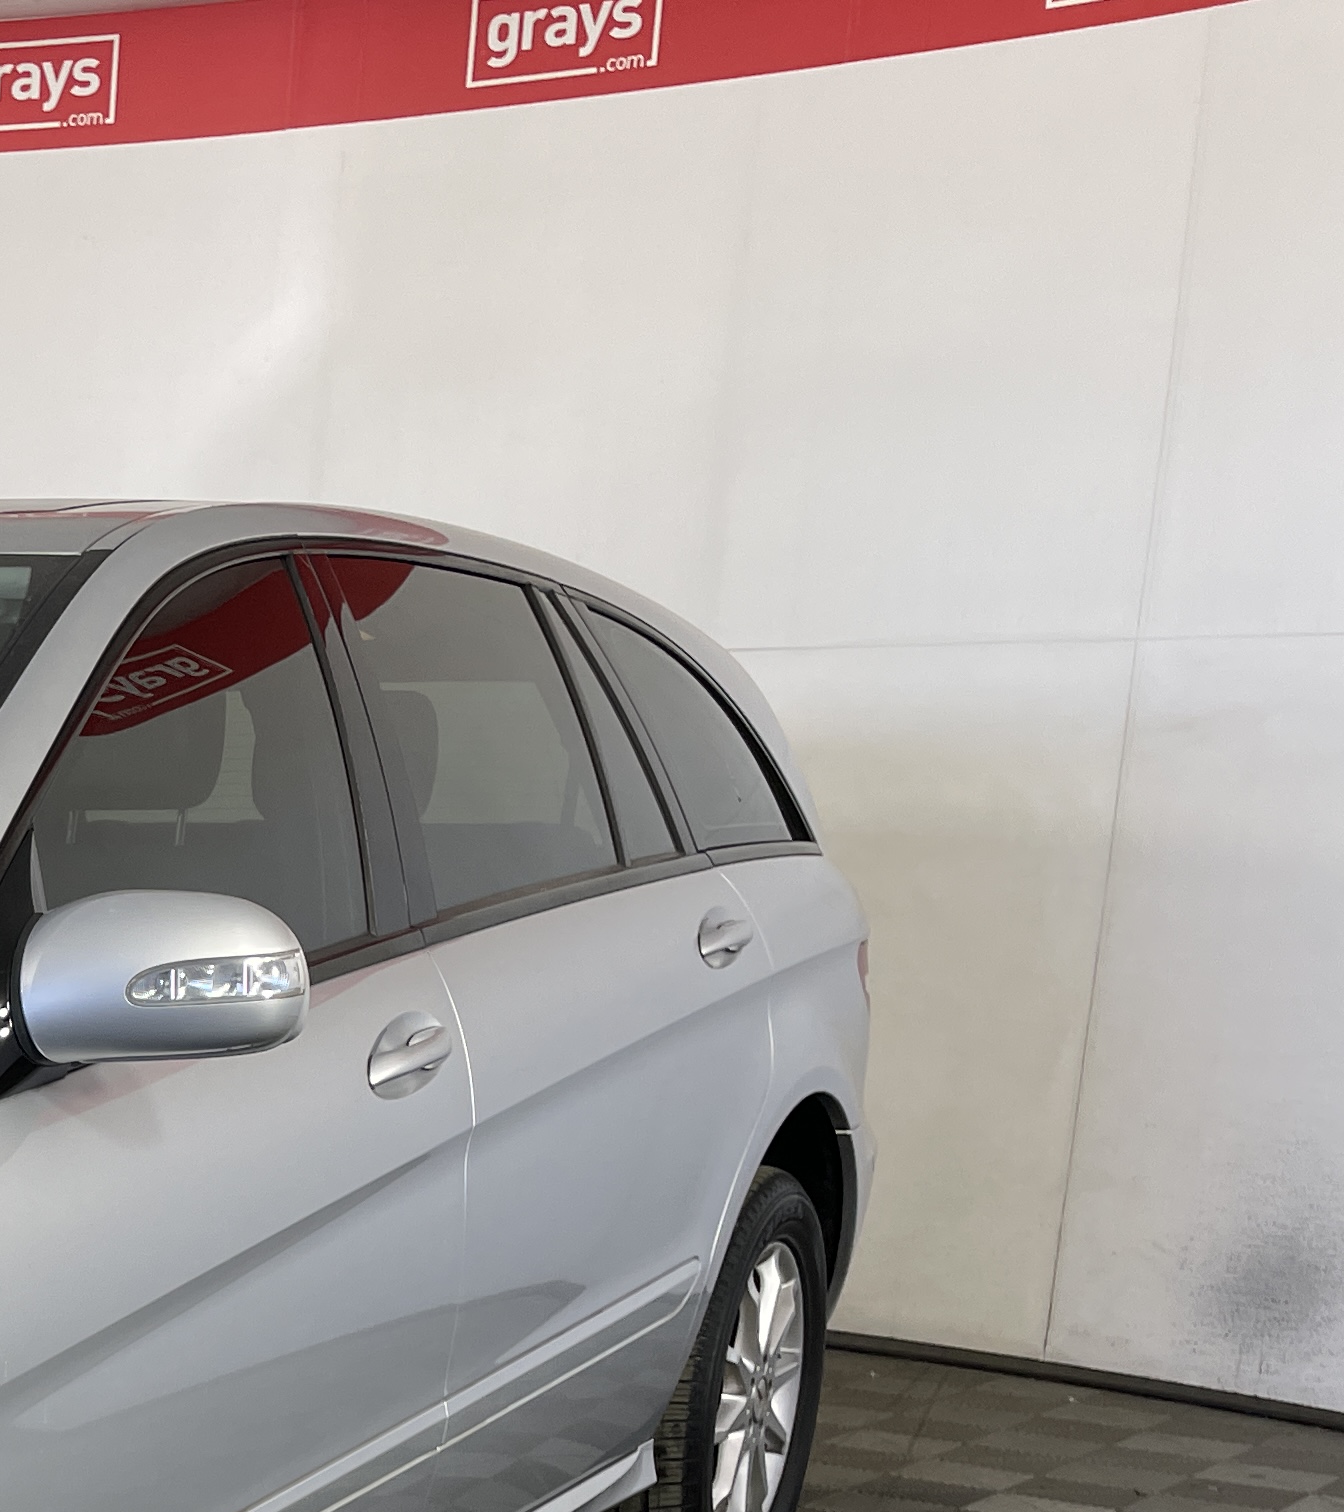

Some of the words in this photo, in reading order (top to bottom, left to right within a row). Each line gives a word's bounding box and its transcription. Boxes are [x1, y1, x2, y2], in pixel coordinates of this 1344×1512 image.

[486, 0, 643, 68] grays
[599, 54, 646, 73] .com
[62, 112, 105, 128] .com
